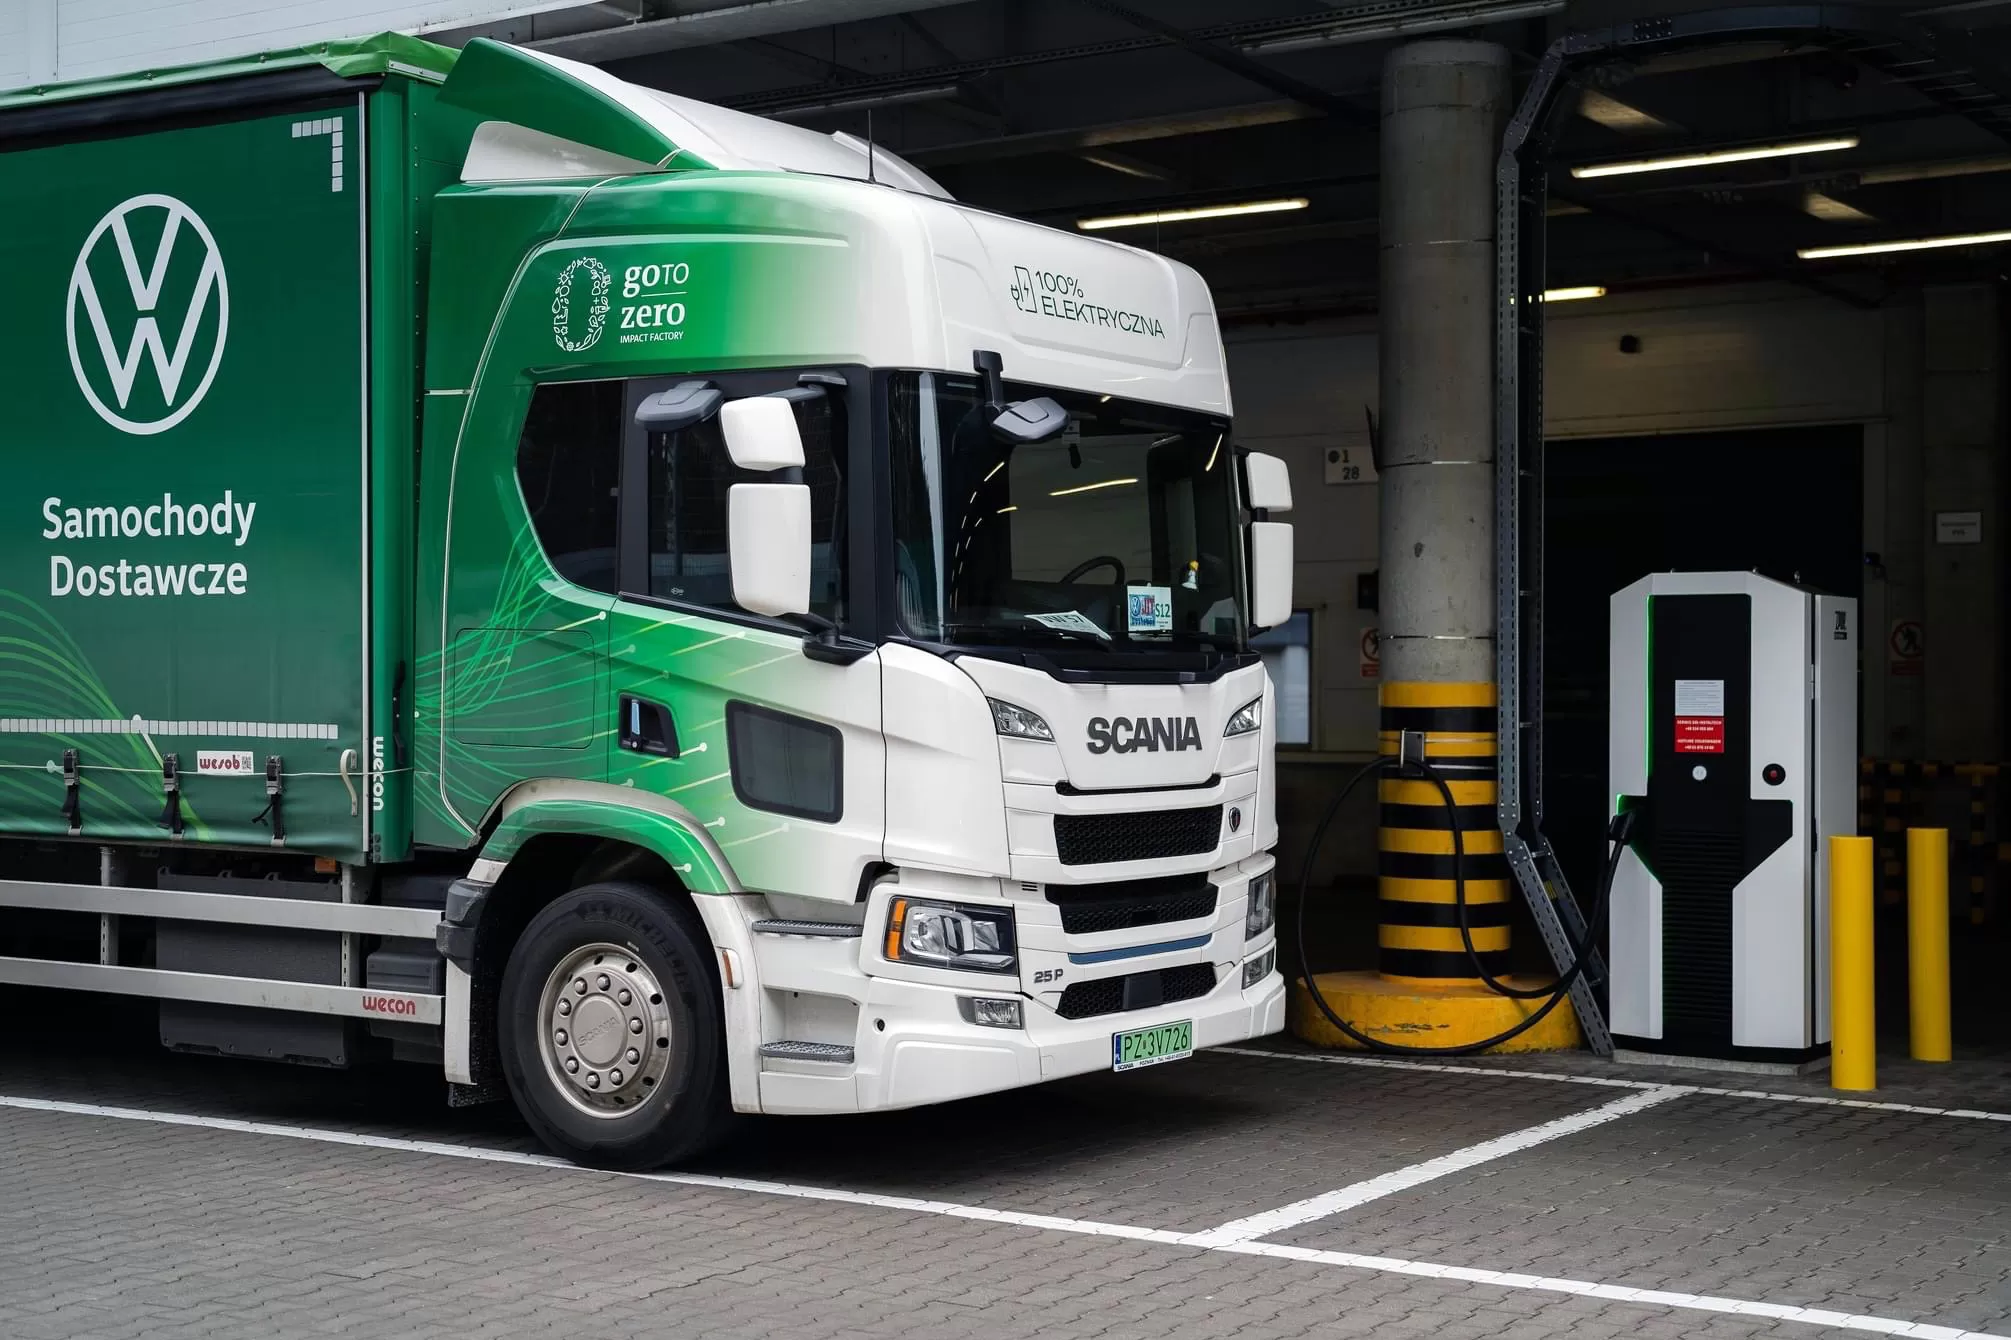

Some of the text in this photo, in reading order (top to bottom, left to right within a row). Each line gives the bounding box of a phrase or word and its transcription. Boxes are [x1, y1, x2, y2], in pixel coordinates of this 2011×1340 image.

[1036, 271, 1084, 298] 100%
[620, 303, 686, 328] zero
[1041, 295, 1165, 339] ELEKTRYCZNA
[620, 331, 683, 343] IMPACT FACTORY
[43, 490, 256, 546] Samochody
[51, 556, 247, 596] Dostawcze
[1155, 604, 1171, 617] S12
[1087, 717, 1202, 754] SCANIA
[373, 736, 384, 811] wecon
[363, 996, 415, 1015] wecon
